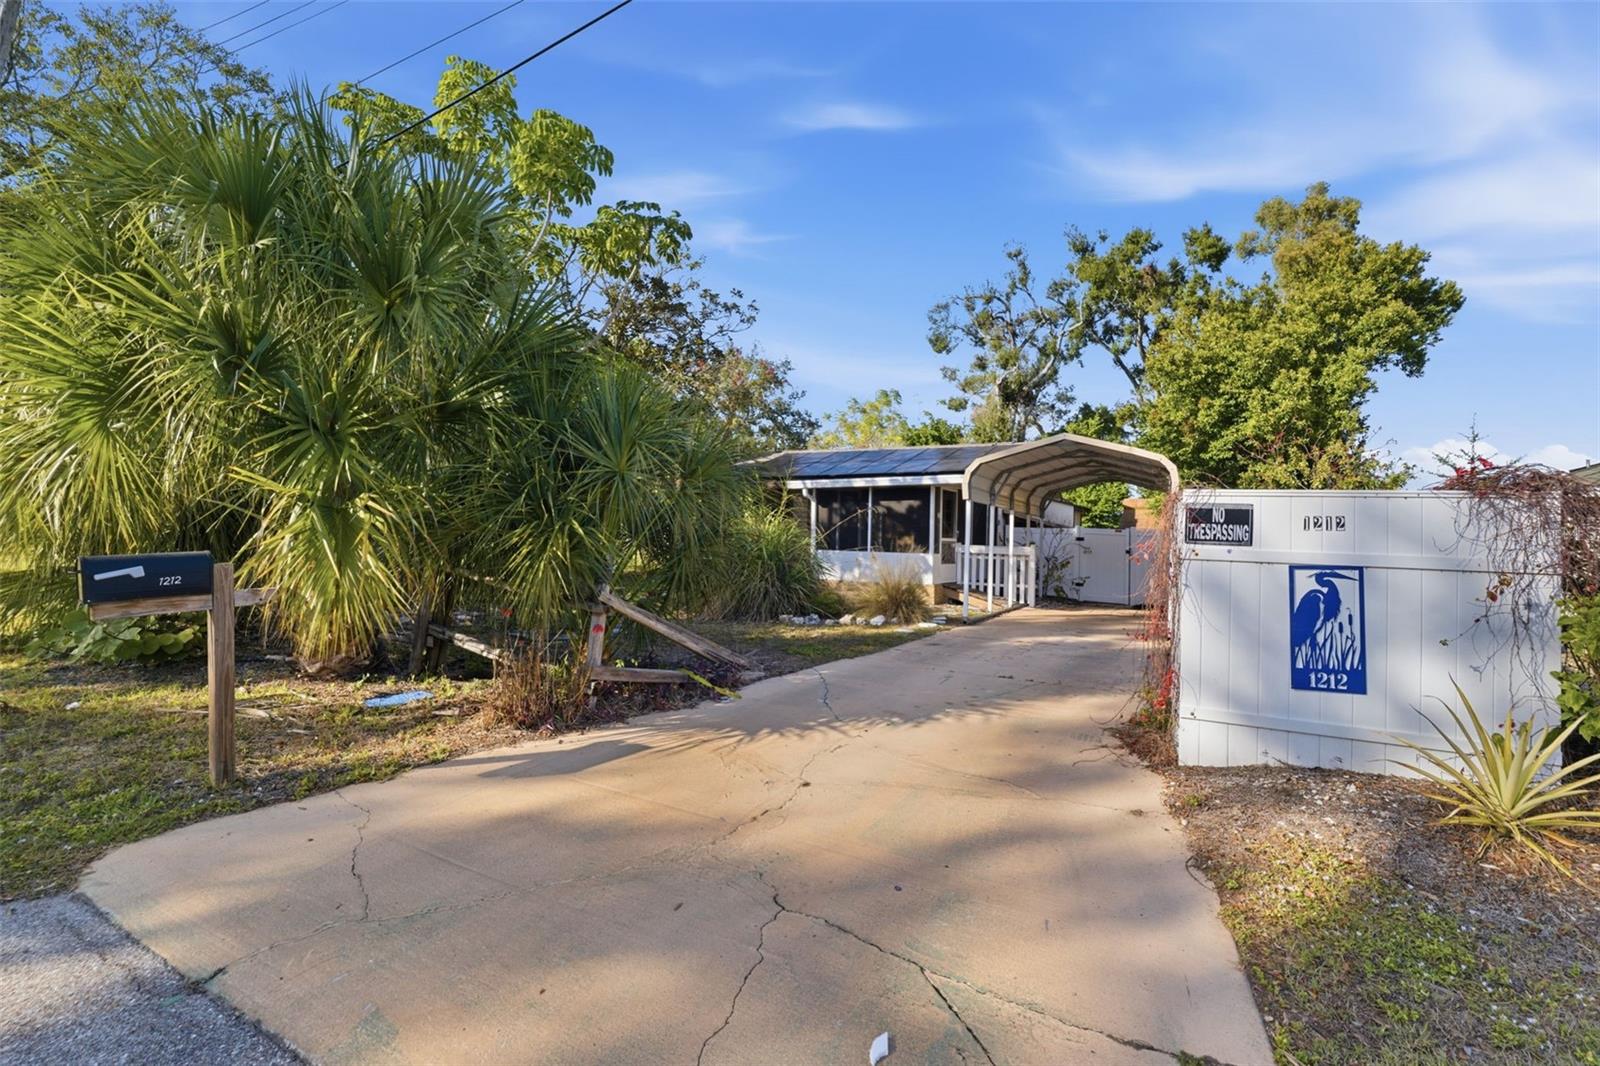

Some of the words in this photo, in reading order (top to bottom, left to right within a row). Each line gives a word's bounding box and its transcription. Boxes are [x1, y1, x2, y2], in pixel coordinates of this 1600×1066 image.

[1212, 508, 1226, 523] NO
[1303, 516, 1346, 531] 1212
[1188, 523, 1249, 541] TRESPASSING
[159, 576, 182, 586] 1212
[1309, 672, 1348, 690] 1212
